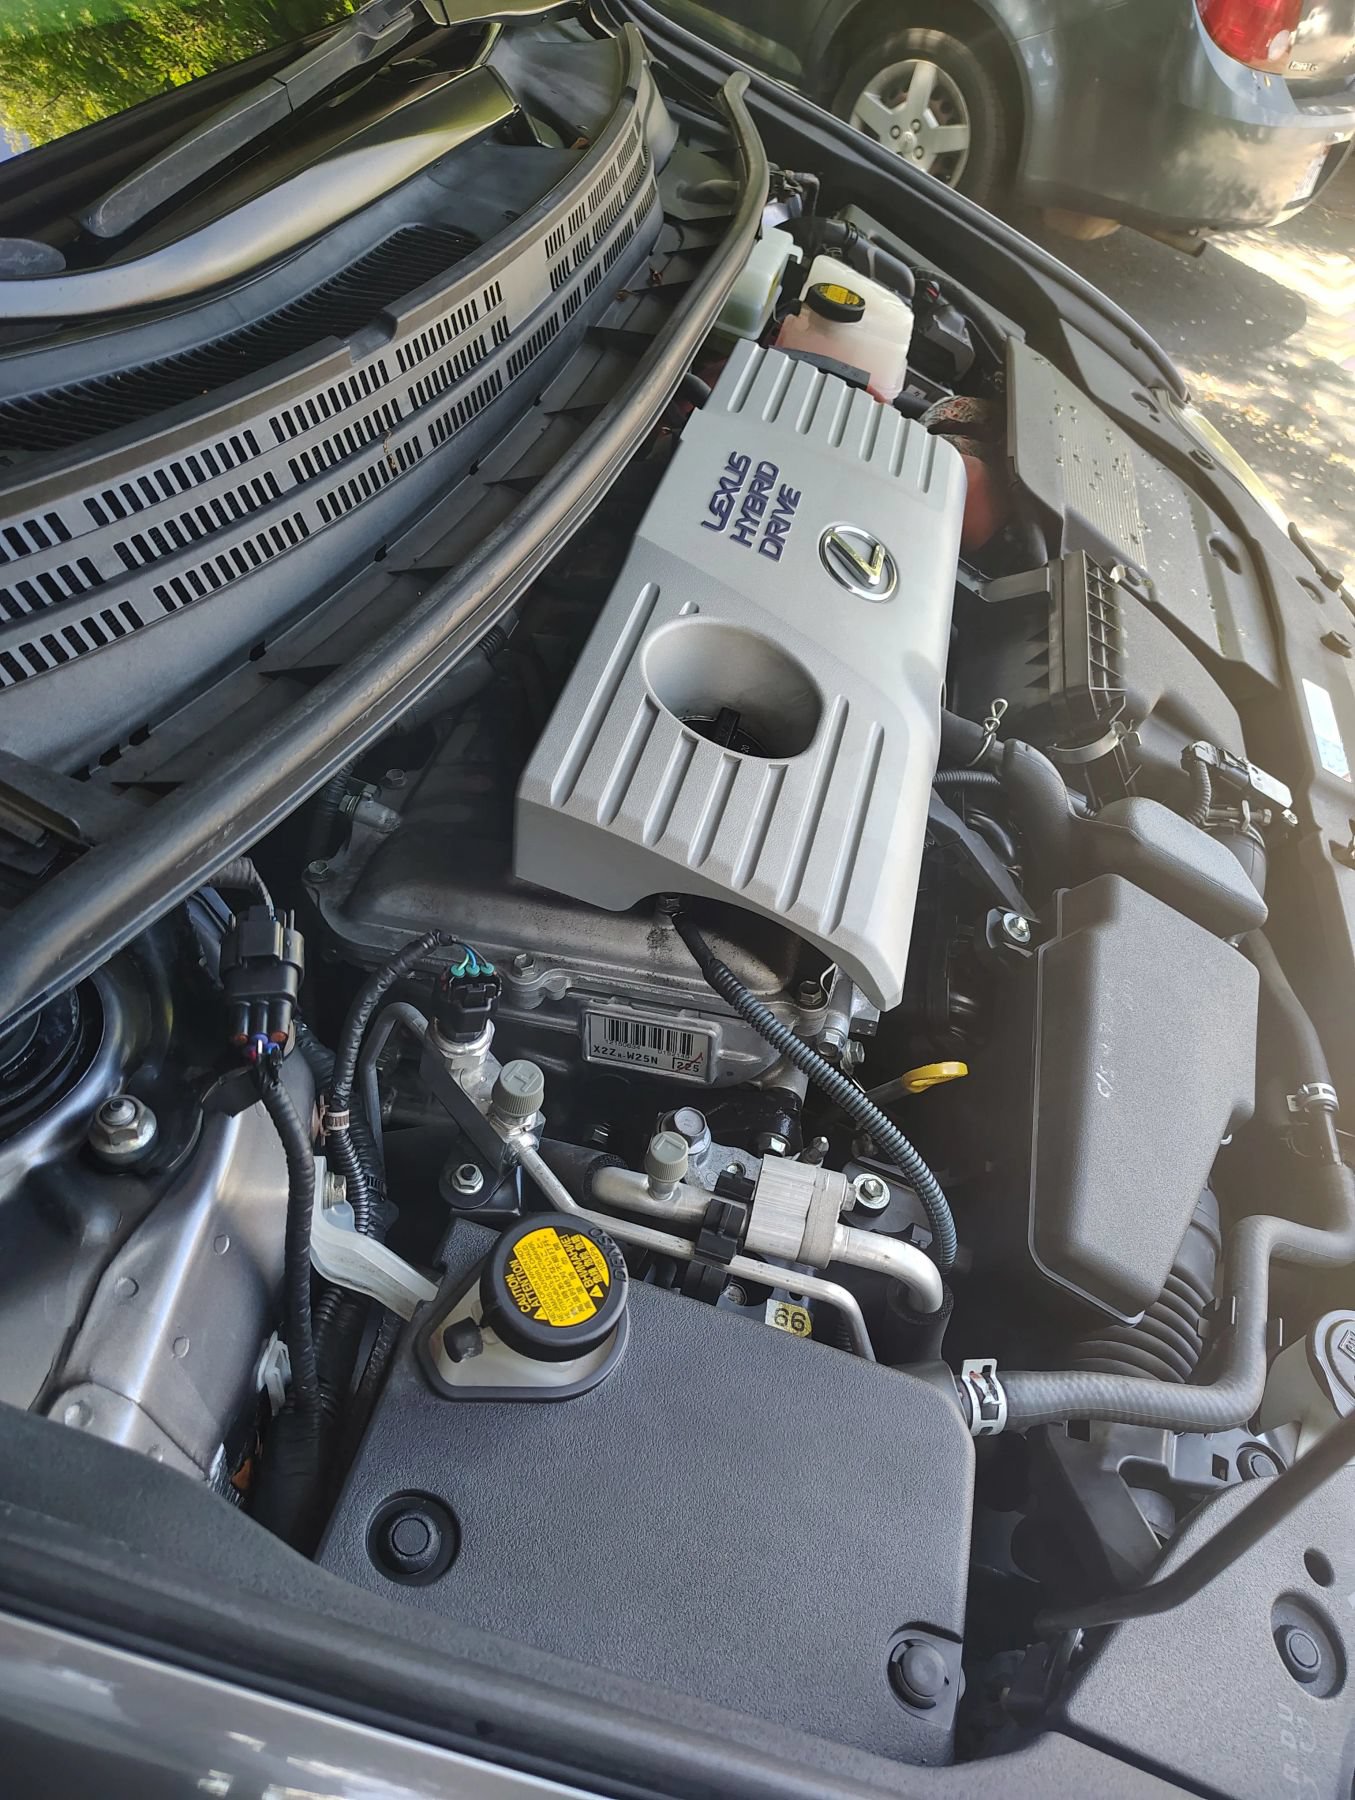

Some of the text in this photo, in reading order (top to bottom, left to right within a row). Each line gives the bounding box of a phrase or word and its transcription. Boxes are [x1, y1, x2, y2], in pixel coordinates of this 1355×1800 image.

[701, 451, 752, 533] LEXUS
[730, 461, 780, 548] HYBRID
[758, 484, 801, 562] DRIVE
[559, 1232, 594, 1288] ВНИМАНИЕ!
[588, 1226, 629, 1283] DENSO
[504, 1272, 531, 1313] CAUTION
[508, 1258, 540, 1308] ATTENTION
[774, 1307, 807, 1332] 66
